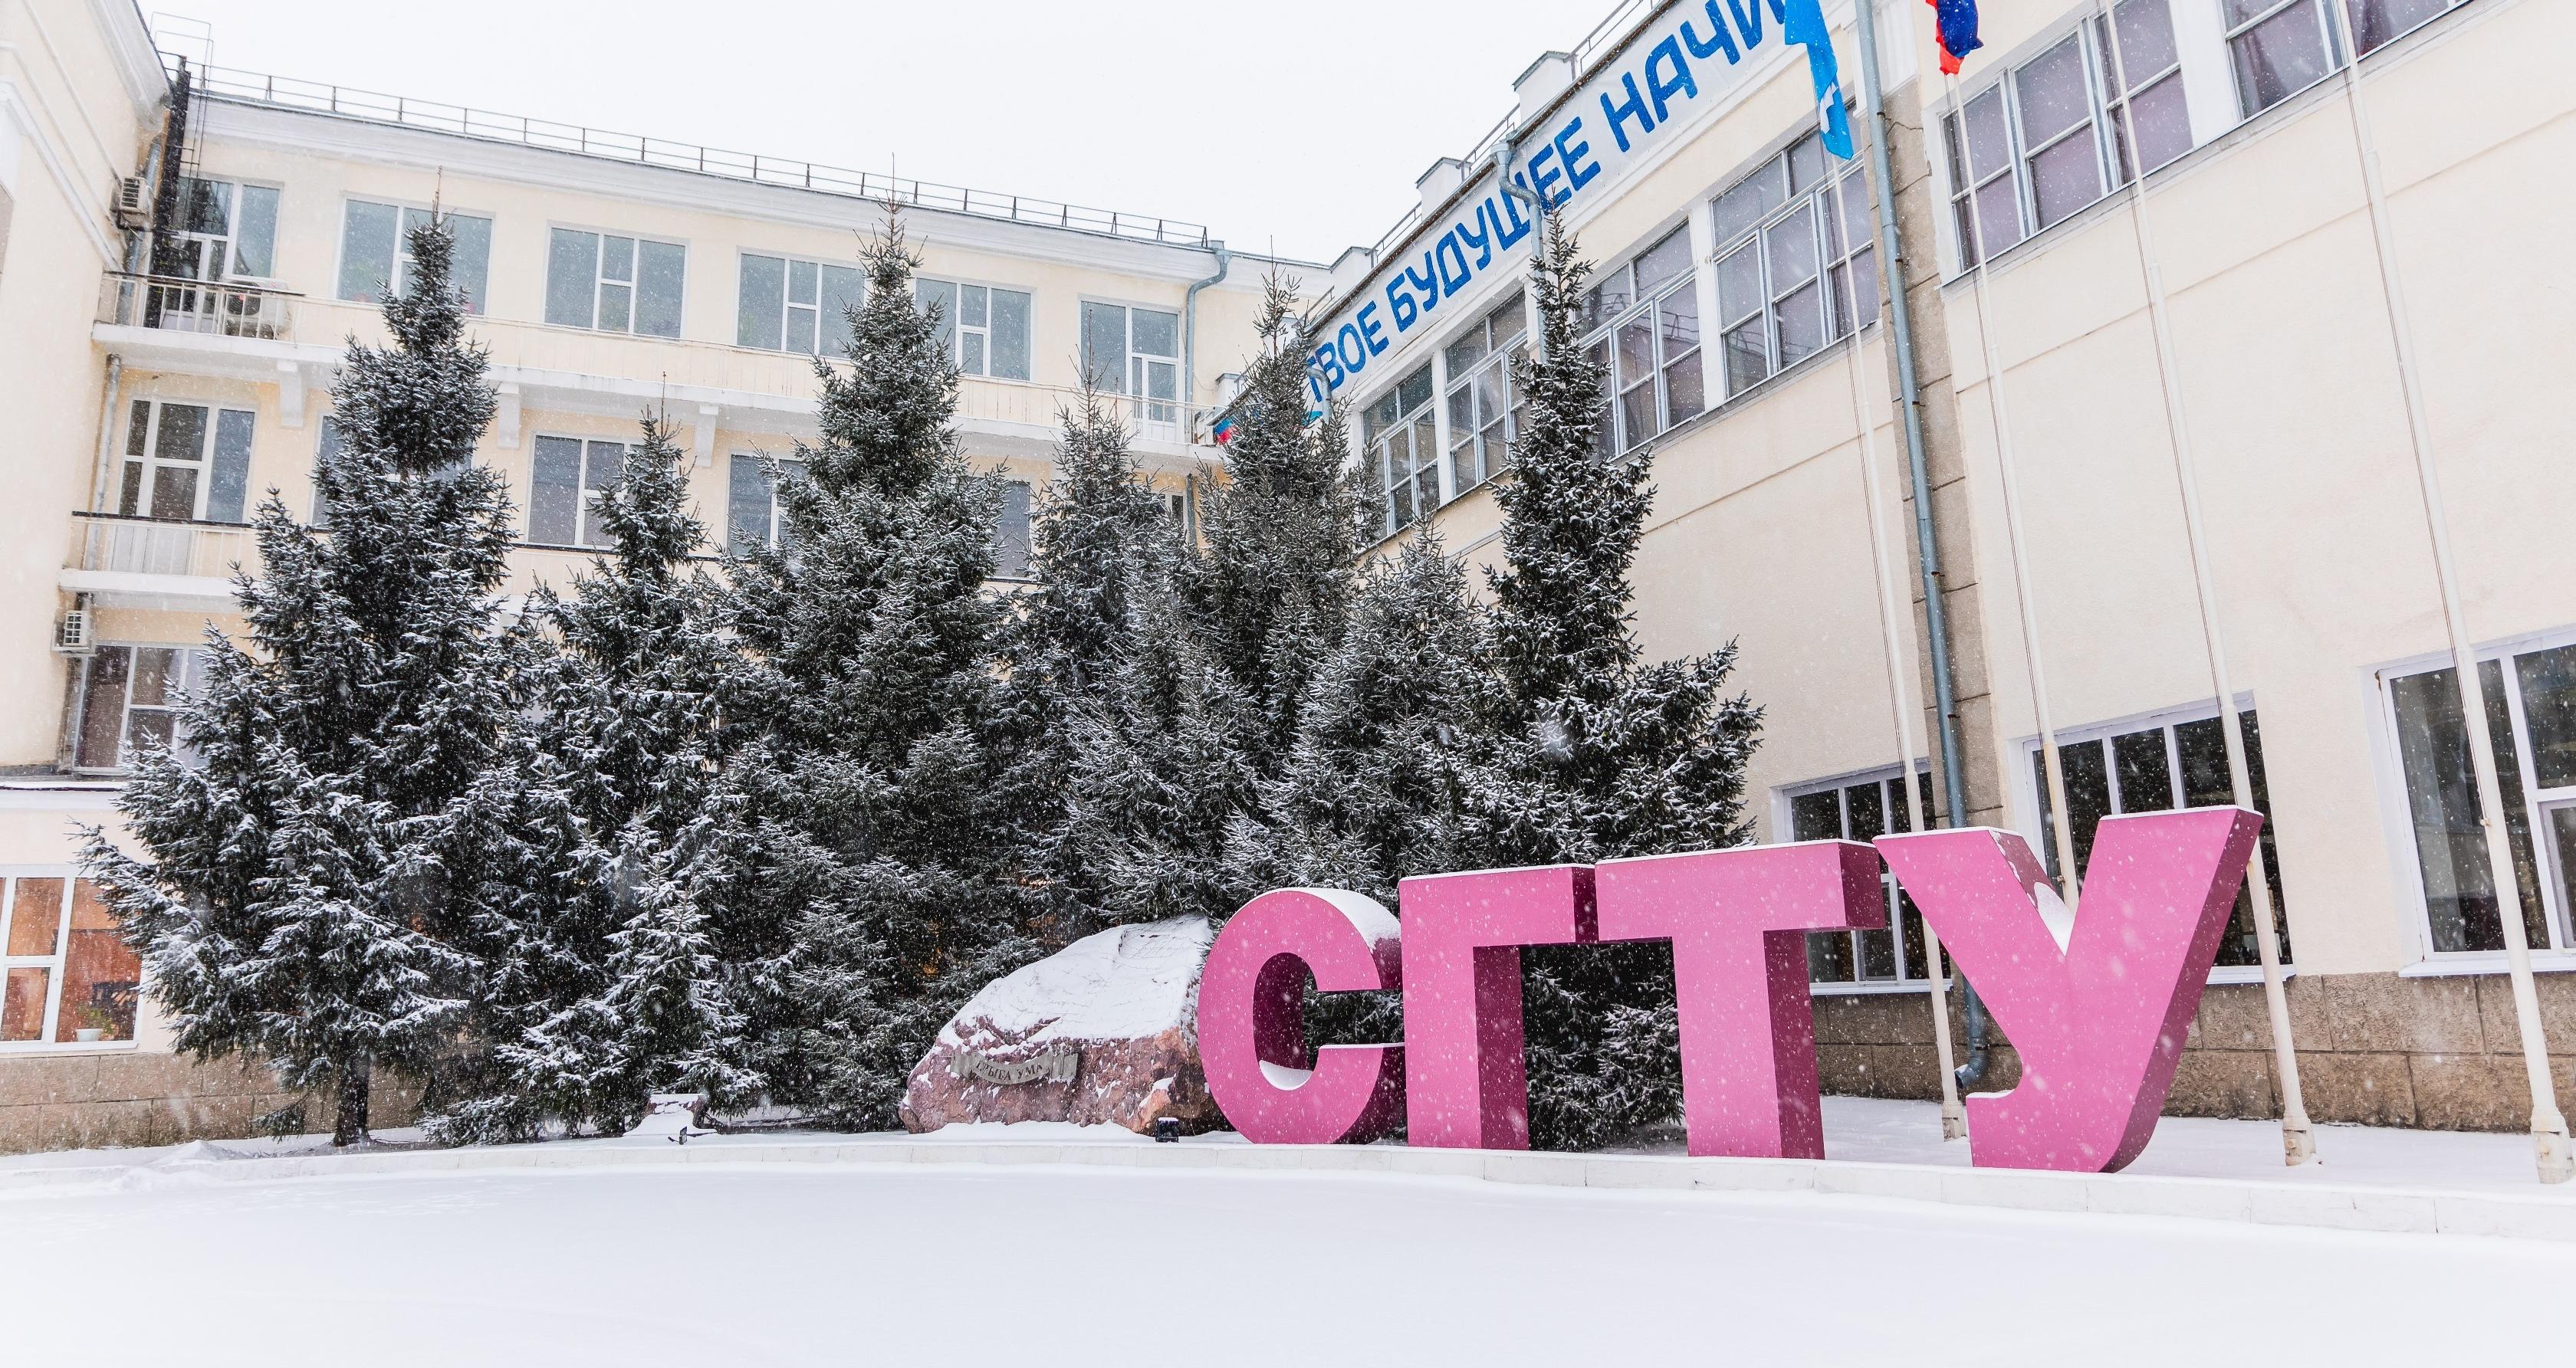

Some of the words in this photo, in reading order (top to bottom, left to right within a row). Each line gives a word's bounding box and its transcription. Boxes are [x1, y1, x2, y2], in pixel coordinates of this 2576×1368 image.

[1385, 116, 1602, 333] БУДУЩЕЕ
[1017, 1061, 1043, 1079] УМА
[1198, 808, 2263, 1173] СГТУ
